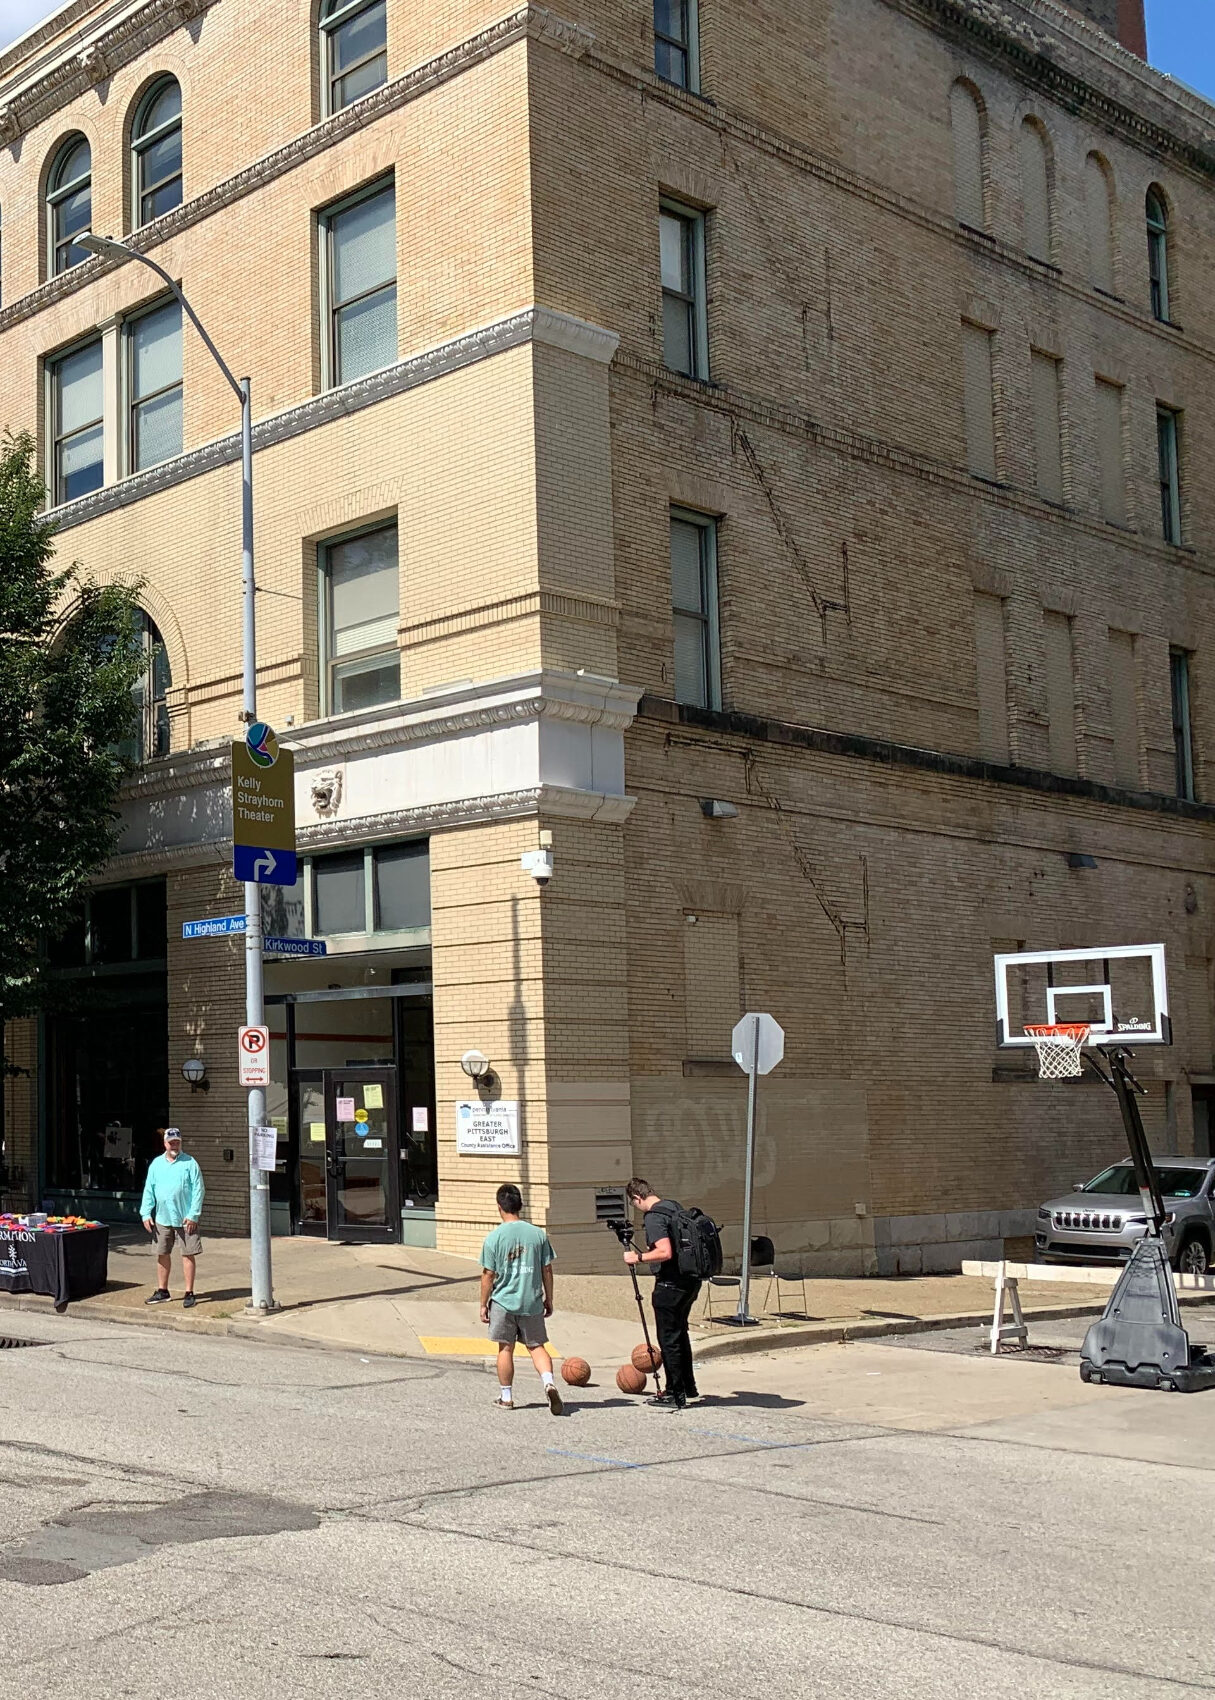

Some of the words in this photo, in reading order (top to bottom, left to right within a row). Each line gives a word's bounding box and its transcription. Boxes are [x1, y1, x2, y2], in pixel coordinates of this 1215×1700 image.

[237, 775, 261, 792] Kelly
[237, 791, 284, 808] Strayhorn
[237, 806, 274, 822] Theater
[185, 925, 192, 936] N
[194, 920, 226, 937] Highland
[229, 918, 245, 931] Ave
[265, 938, 310, 954] Kirkwood
[312, 941, 323, 955] St
